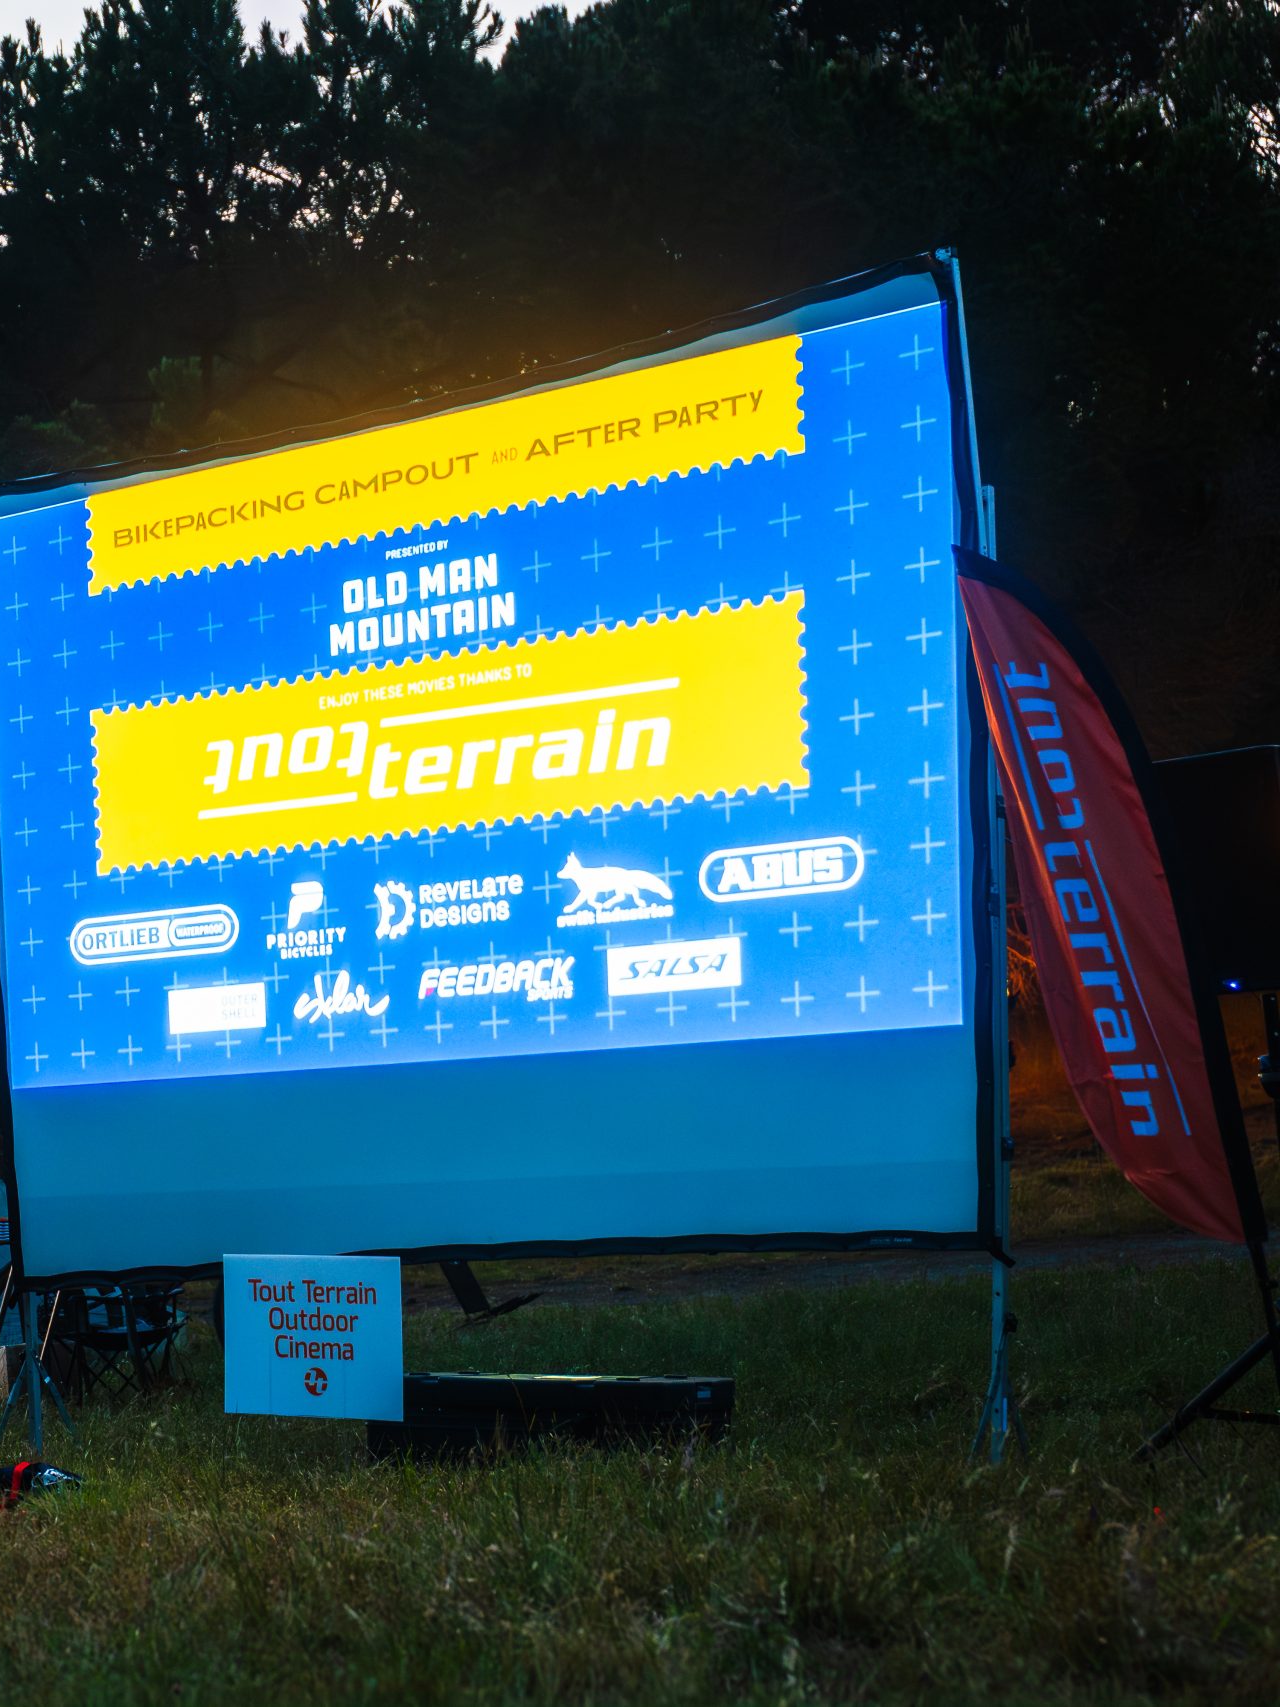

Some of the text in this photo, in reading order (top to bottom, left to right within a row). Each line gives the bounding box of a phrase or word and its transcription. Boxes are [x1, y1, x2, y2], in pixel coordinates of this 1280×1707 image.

[114, 389, 763, 548] BIKEPACKING CAMPOUT AND AFTER PARTY
[385, 540, 448, 560] PRESENTED BY
[343, 553, 498, 614] OLD MAN
[329, 591, 516, 657] MOUNTAIN
[318, 663, 533, 710] ENJOY THESE MOVIES THANKS TO
[368, 709, 672, 800] terrain
[717, 846, 844, 893] ABUS
[82, 927, 160, 951] ORTLIEB
[266, 926, 346, 950] PRIORITY
[280, 943, 333, 960] BICYCLES
[418, 955, 575, 1000] FEEDBACK
[619, 953, 728, 981] SALSA
[1044, 840, 1160, 1137] terrain
[247, 1278, 377, 1304] Tout Terrain
[269, 1307, 358, 1332] Outdoor
[274, 1335, 354, 1360] Cinema
